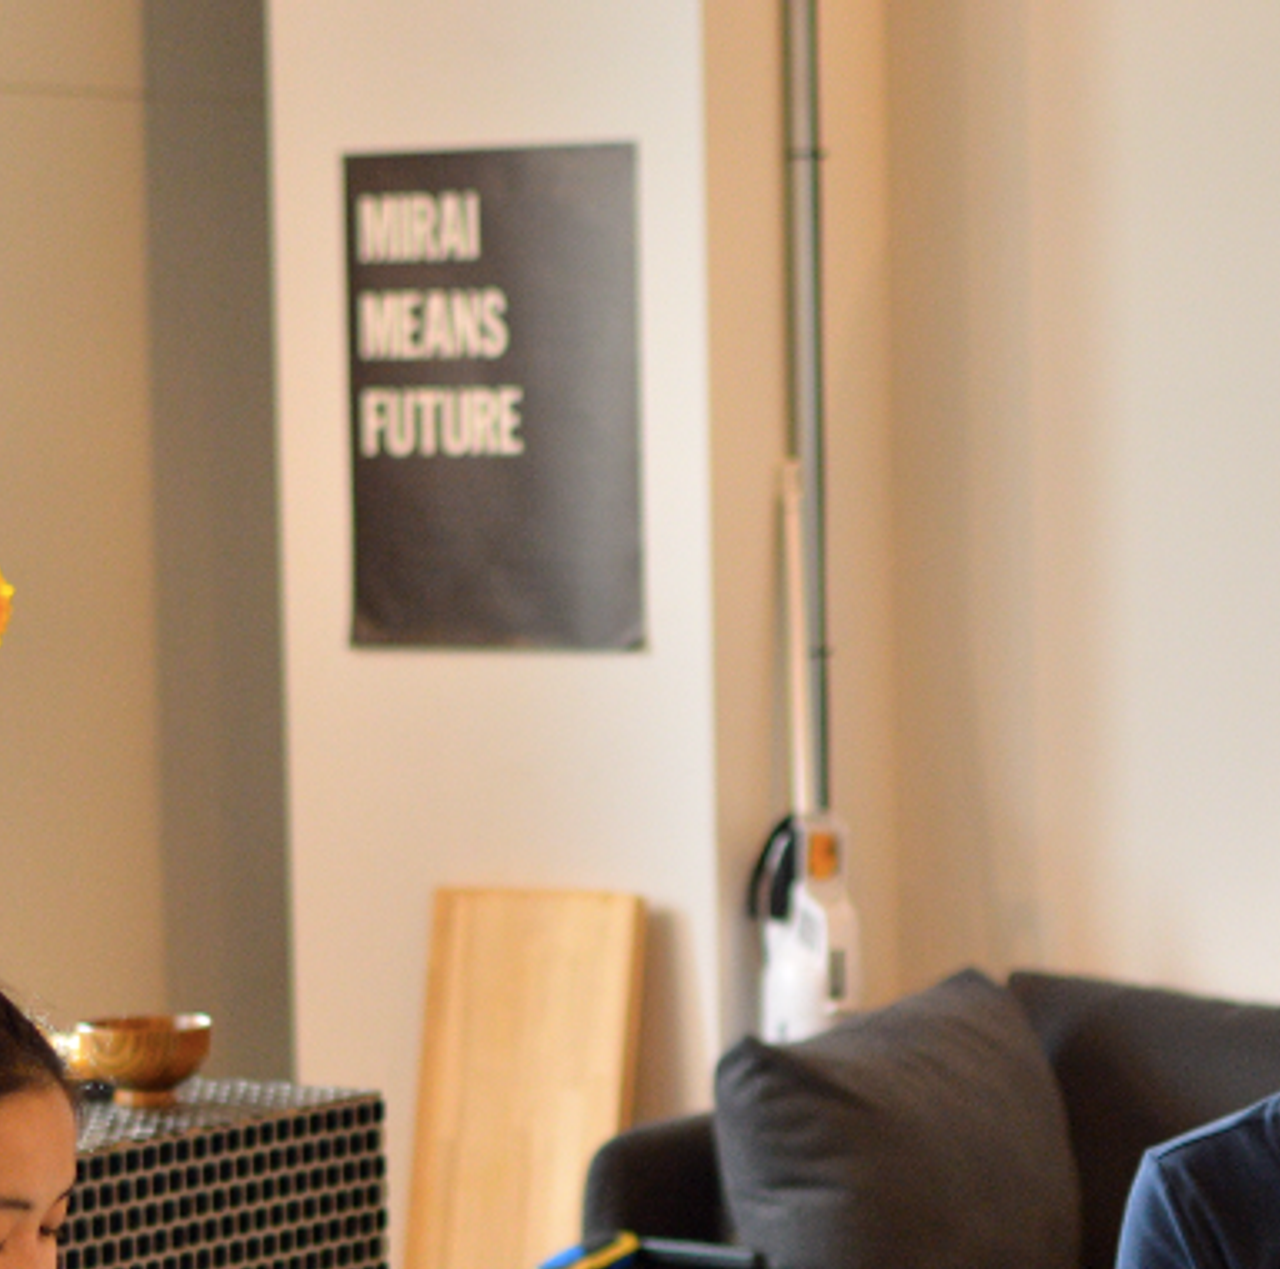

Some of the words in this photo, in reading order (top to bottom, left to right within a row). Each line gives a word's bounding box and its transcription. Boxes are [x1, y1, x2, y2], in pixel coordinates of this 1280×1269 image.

[357, 192, 481, 263] MIRAI
[358, 287, 509, 360] MEANS
[359, 385, 524, 458] FUTURE
